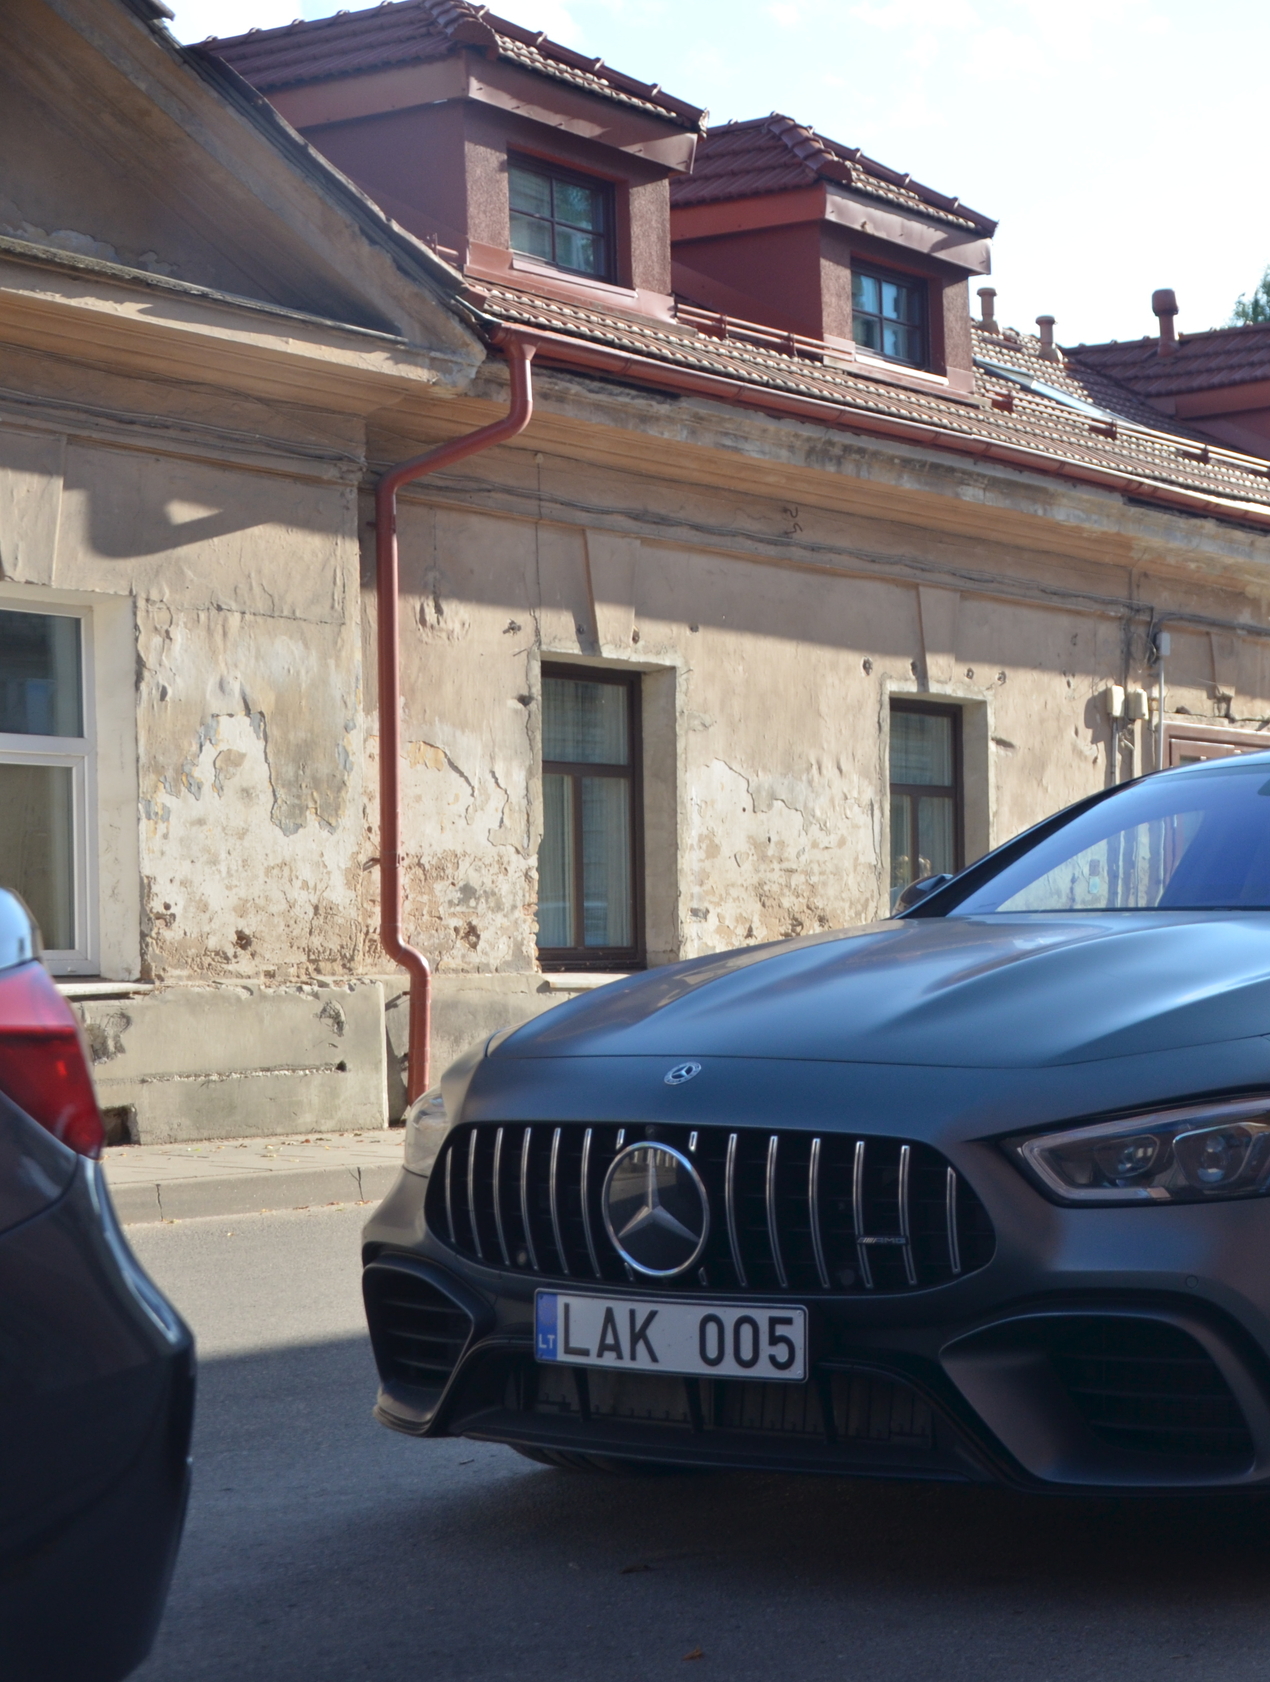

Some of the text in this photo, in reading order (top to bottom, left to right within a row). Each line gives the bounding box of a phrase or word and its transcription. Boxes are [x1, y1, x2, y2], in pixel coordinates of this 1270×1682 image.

[538, 1333, 556, 1349] LT
[563, 1302, 796, 1371] LAK 005
